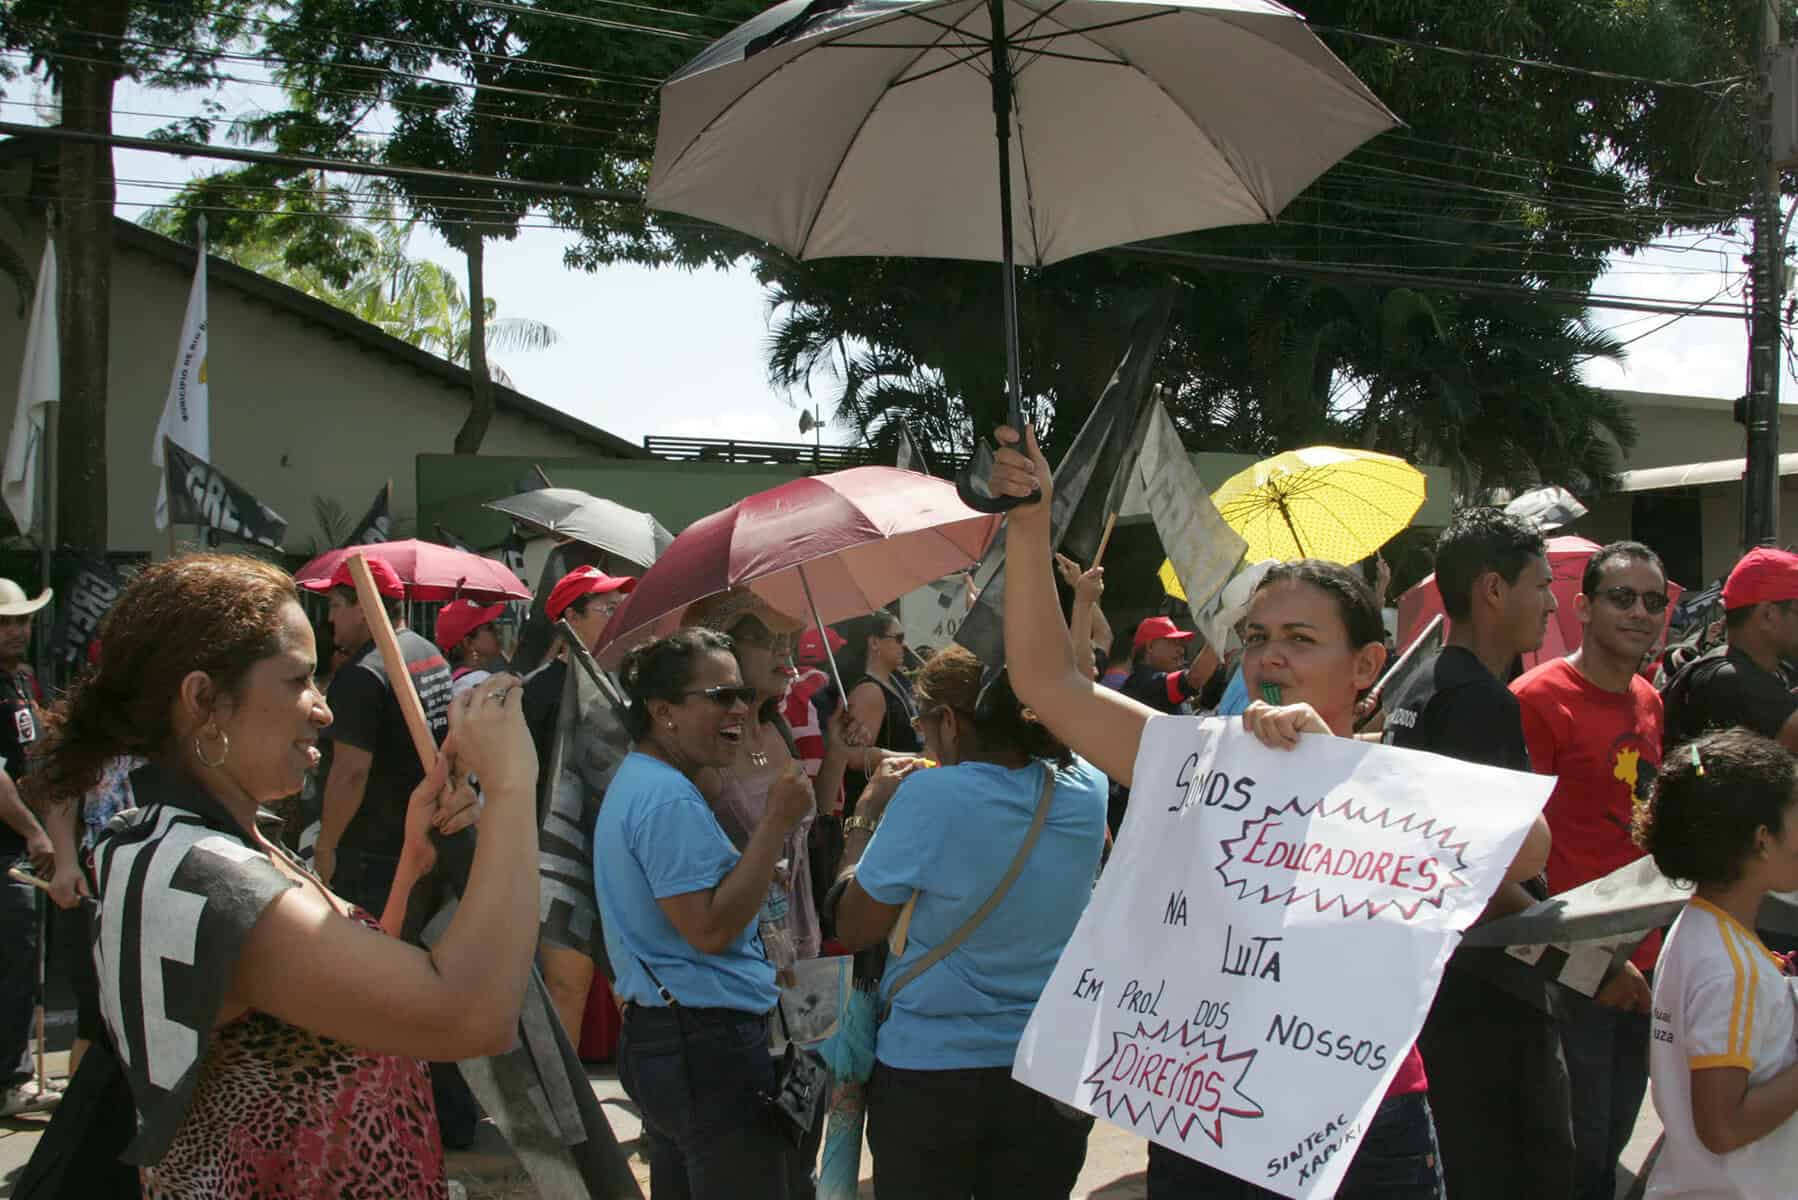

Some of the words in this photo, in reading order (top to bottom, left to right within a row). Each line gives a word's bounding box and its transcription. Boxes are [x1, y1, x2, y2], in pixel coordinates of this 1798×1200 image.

[1242, 822, 1439, 892] EDUCADORES
[1163, 890, 1188, 926] NA
[1221, 924, 1283, 982] LUTA
[1072, 968, 1104, 1000] EM
[1117, 979, 1165, 1016] PROL
[1193, 1000, 1230, 1030] DOS
[1265, 1014, 1387, 1070] NOSSOS
[1112, 1043, 1225, 1111] DIREITOS
[1266, 1113, 1348, 1177] SINTEAC
